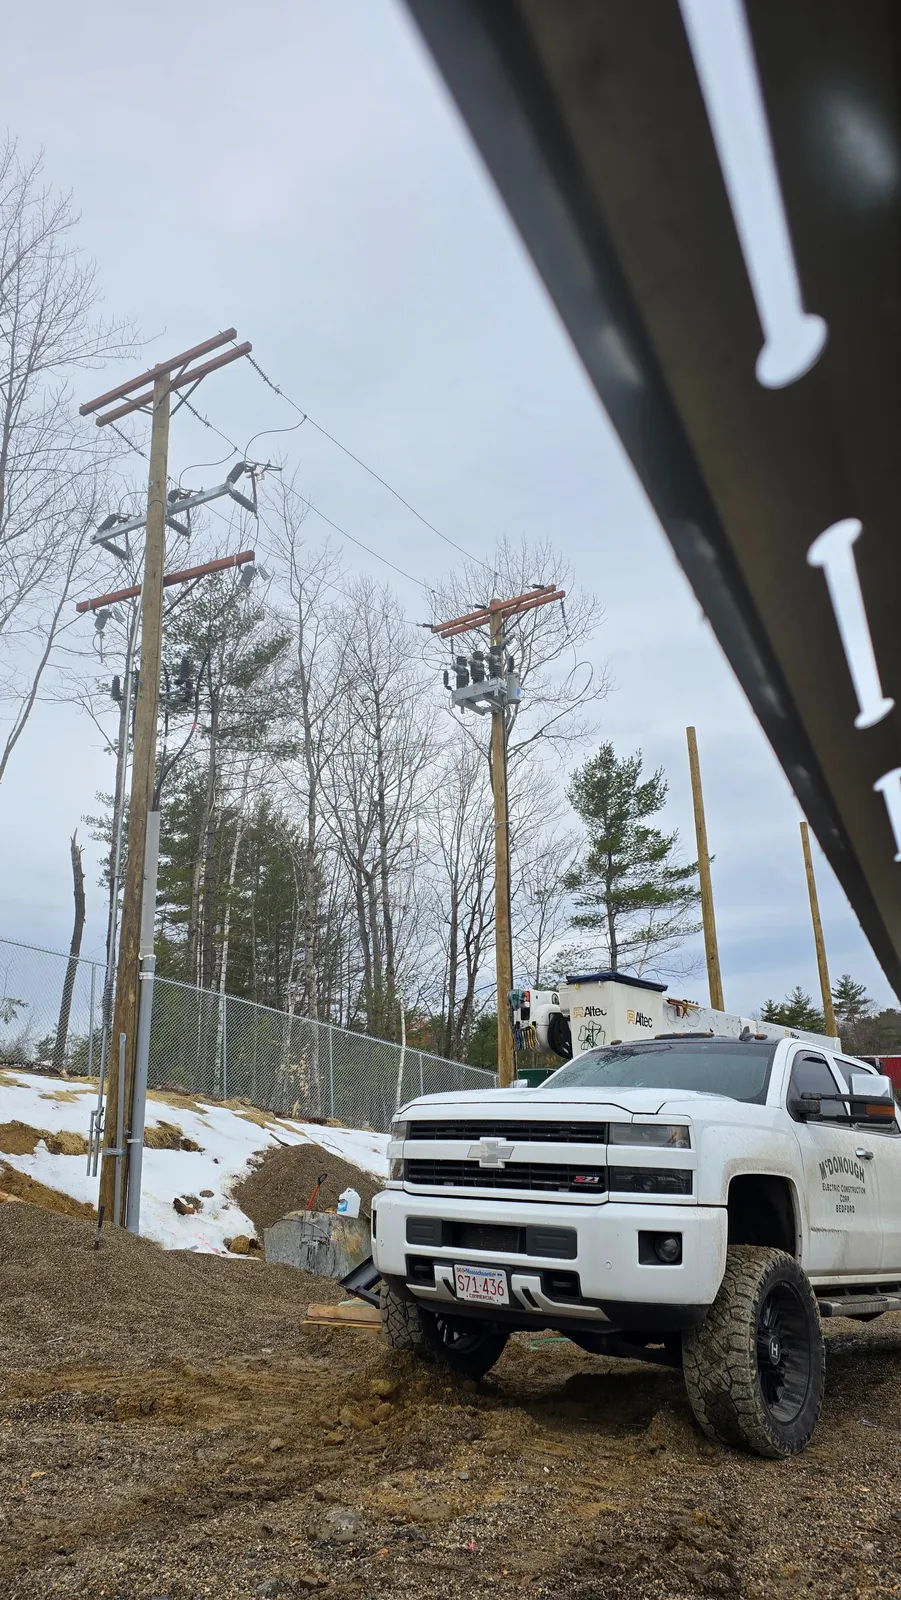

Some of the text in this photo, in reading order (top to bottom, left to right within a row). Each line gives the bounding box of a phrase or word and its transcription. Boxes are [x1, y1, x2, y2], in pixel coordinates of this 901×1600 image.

[584, 1006, 607, 1017] Altec
[635, 1012, 653, 1028] Altec
[819, 1156, 865, 1184] McDONOUGH
[835, 1204, 856, 1214] BEDFORD
[469, 1293, 495, 1302] COMMERCIAL
